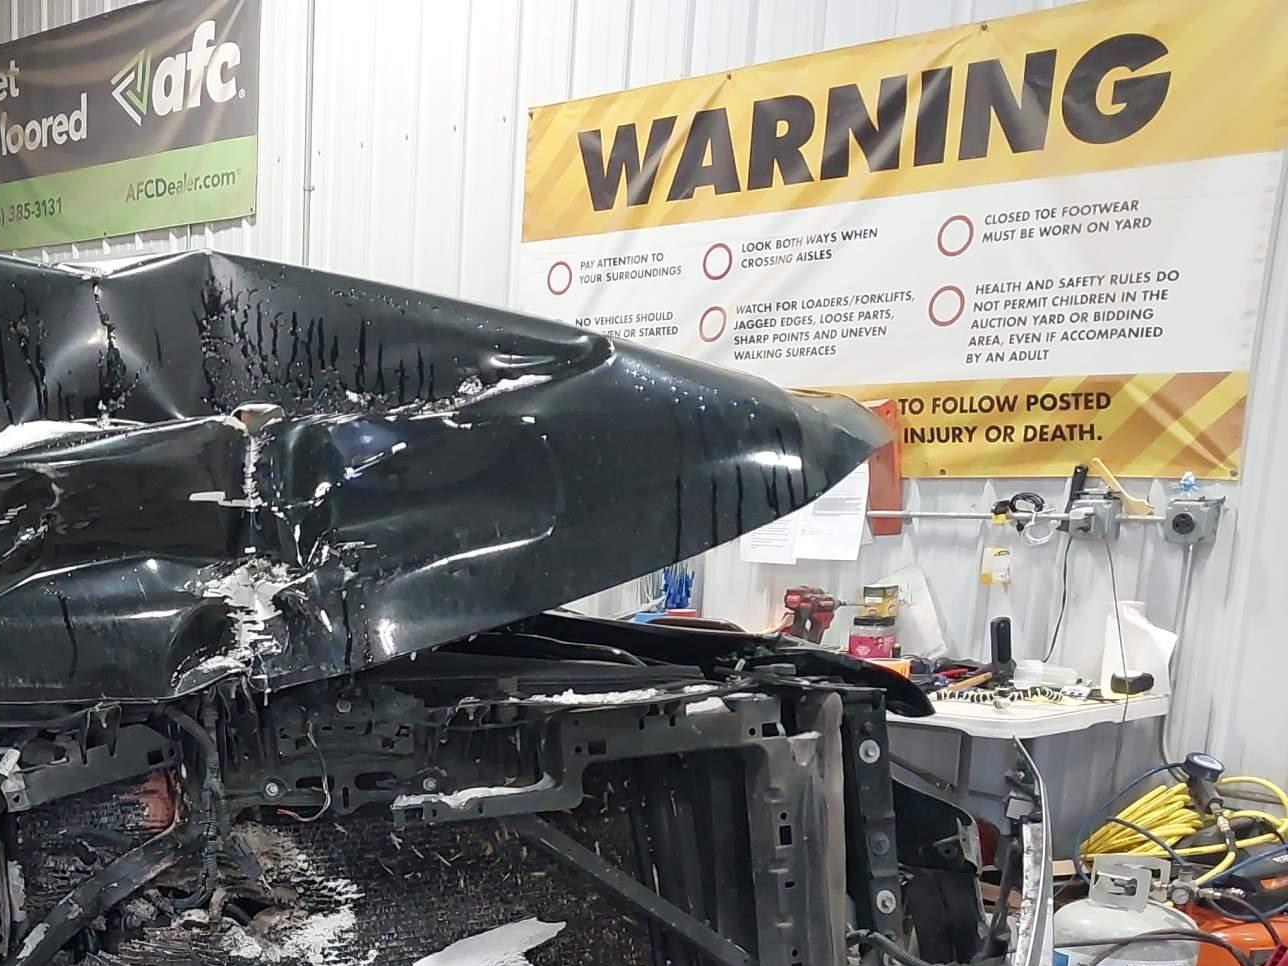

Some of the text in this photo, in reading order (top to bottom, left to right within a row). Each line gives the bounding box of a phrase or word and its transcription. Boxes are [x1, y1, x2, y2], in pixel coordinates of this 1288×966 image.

[578, 33, 1171, 211] WARNING
[125, 170, 236, 202] AFCDealer.com
[7, 198, 62, 223] 385-3131
[984, 200, 1139, 226] CLOSED TOE FOOTWEAR
[742, 228, 878, 253] LOOK BOTH WAYS WHEN
[982, 217, 1152, 243] MUST BE WORN ON YARD
[580, 252, 664, 270] PAY ATTENTION TO
[741, 249, 832, 269] CROSSING AISLES
[579, 265, 682, 284] YOUR SURROUNDINGS
[975, 269, 1180, 295] HEALTH AND SAFETY RULES DO
[736, 291, 915, 315] WATCH FOR LOADERS/FORKLIFTS,
[973, 289, 1169, 313] NOT PERMIT CHILDREN IN THE
[575, 311, 674, 327] NO VEHICLES SHOULD
[733, 309, 894, 331] JAGGED EDGES, LOOSE PARTS,
[970, 308, 1154, 329] AUCTION YARD OR BIDDING
[623, 328, 636, 338] OR
[639, 326, 679, 337] STARTED
[734, 326, 887, 346] SHARP POINTS AND UNEVEN
[968, 326, 1163, 348] AREA, EVEN IF ACCOMPANIED
[734, 345, 836, 361] WALKING SURFACES
[966, 349, 1049, 364] BY AN ADULT
[898, 392, 1111, 415] TO FOLLOW POSTED
[904, 424, 1103, 444] INJURY OR DEATH.
